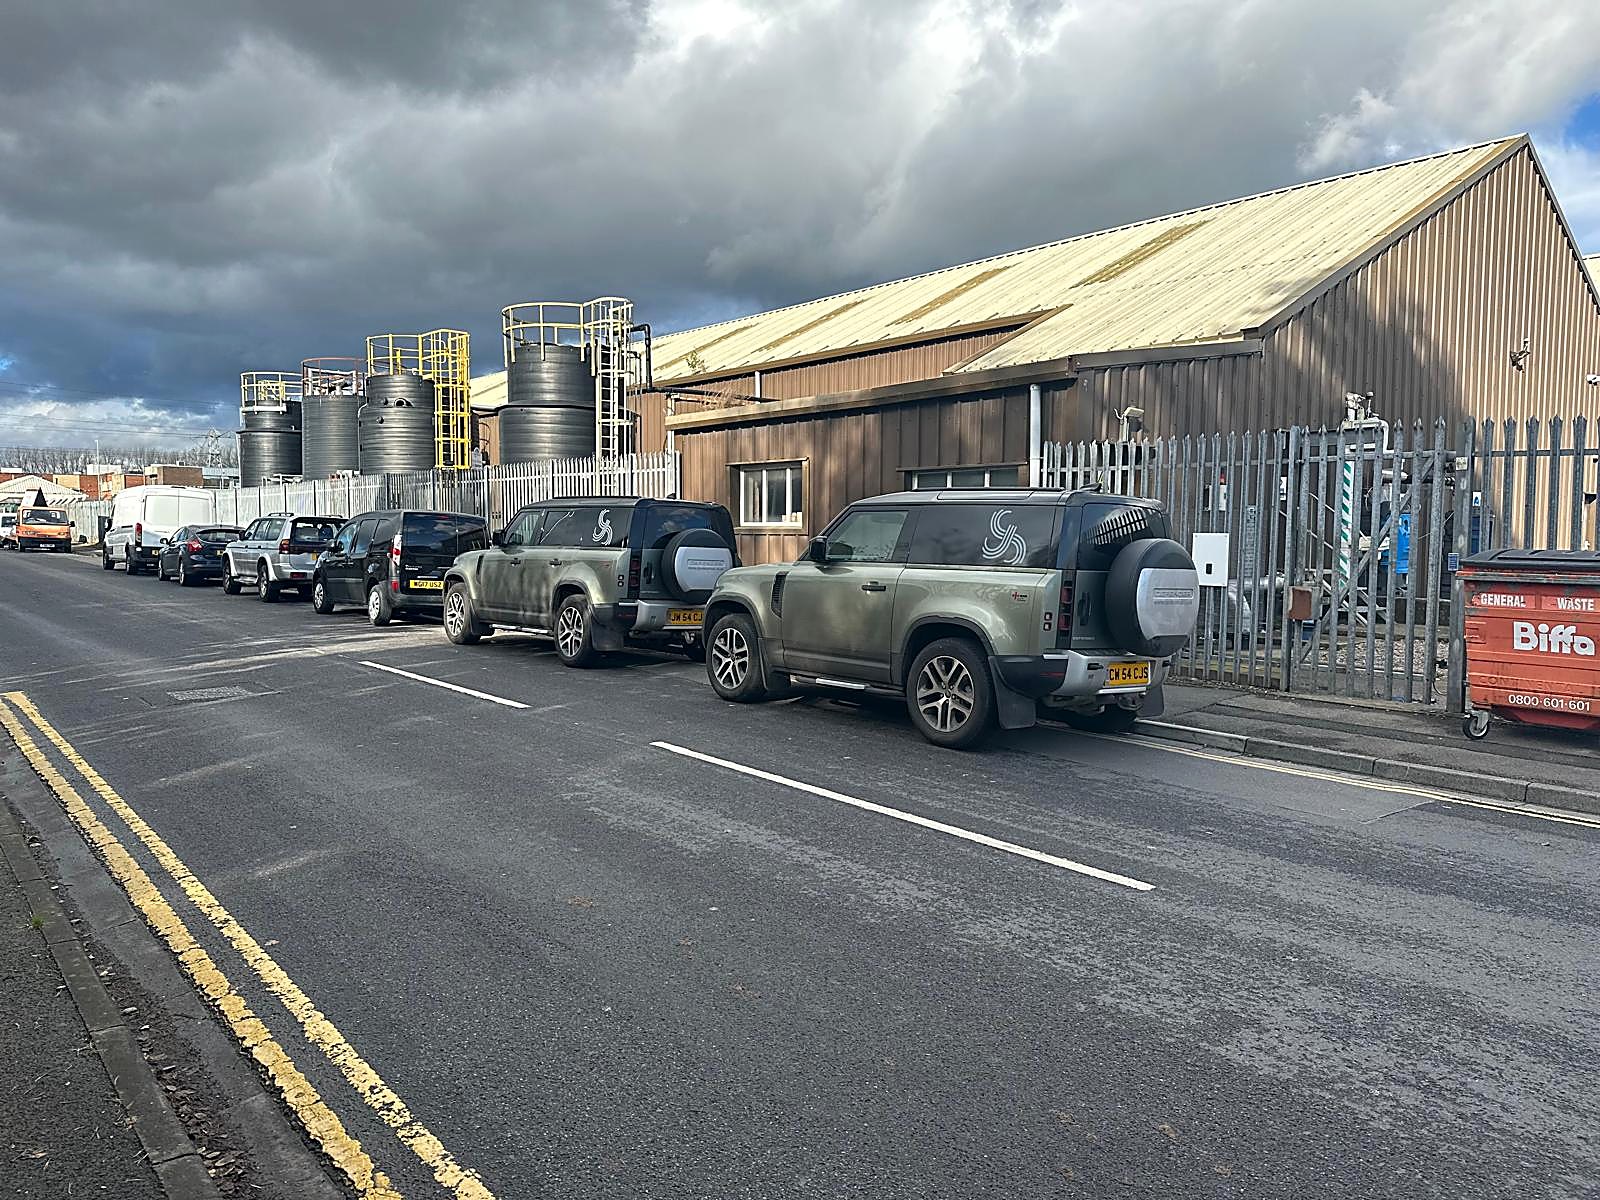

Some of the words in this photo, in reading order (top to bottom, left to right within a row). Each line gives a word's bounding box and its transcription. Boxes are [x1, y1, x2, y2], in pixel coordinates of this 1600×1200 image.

[1480, 592, 1527, 608] GENERAL
[1556, 596, 1595, 612] WASTE
[682, 612, 692, 622] 54
[693, 612, 703, 622] CJ
[1513, 621, 1596, 656] Biffa
[1108, 668, 1120, 681] CW
[1121, 667, 1132, 680] 54
[1133, 666, 1149, 680] CJS
